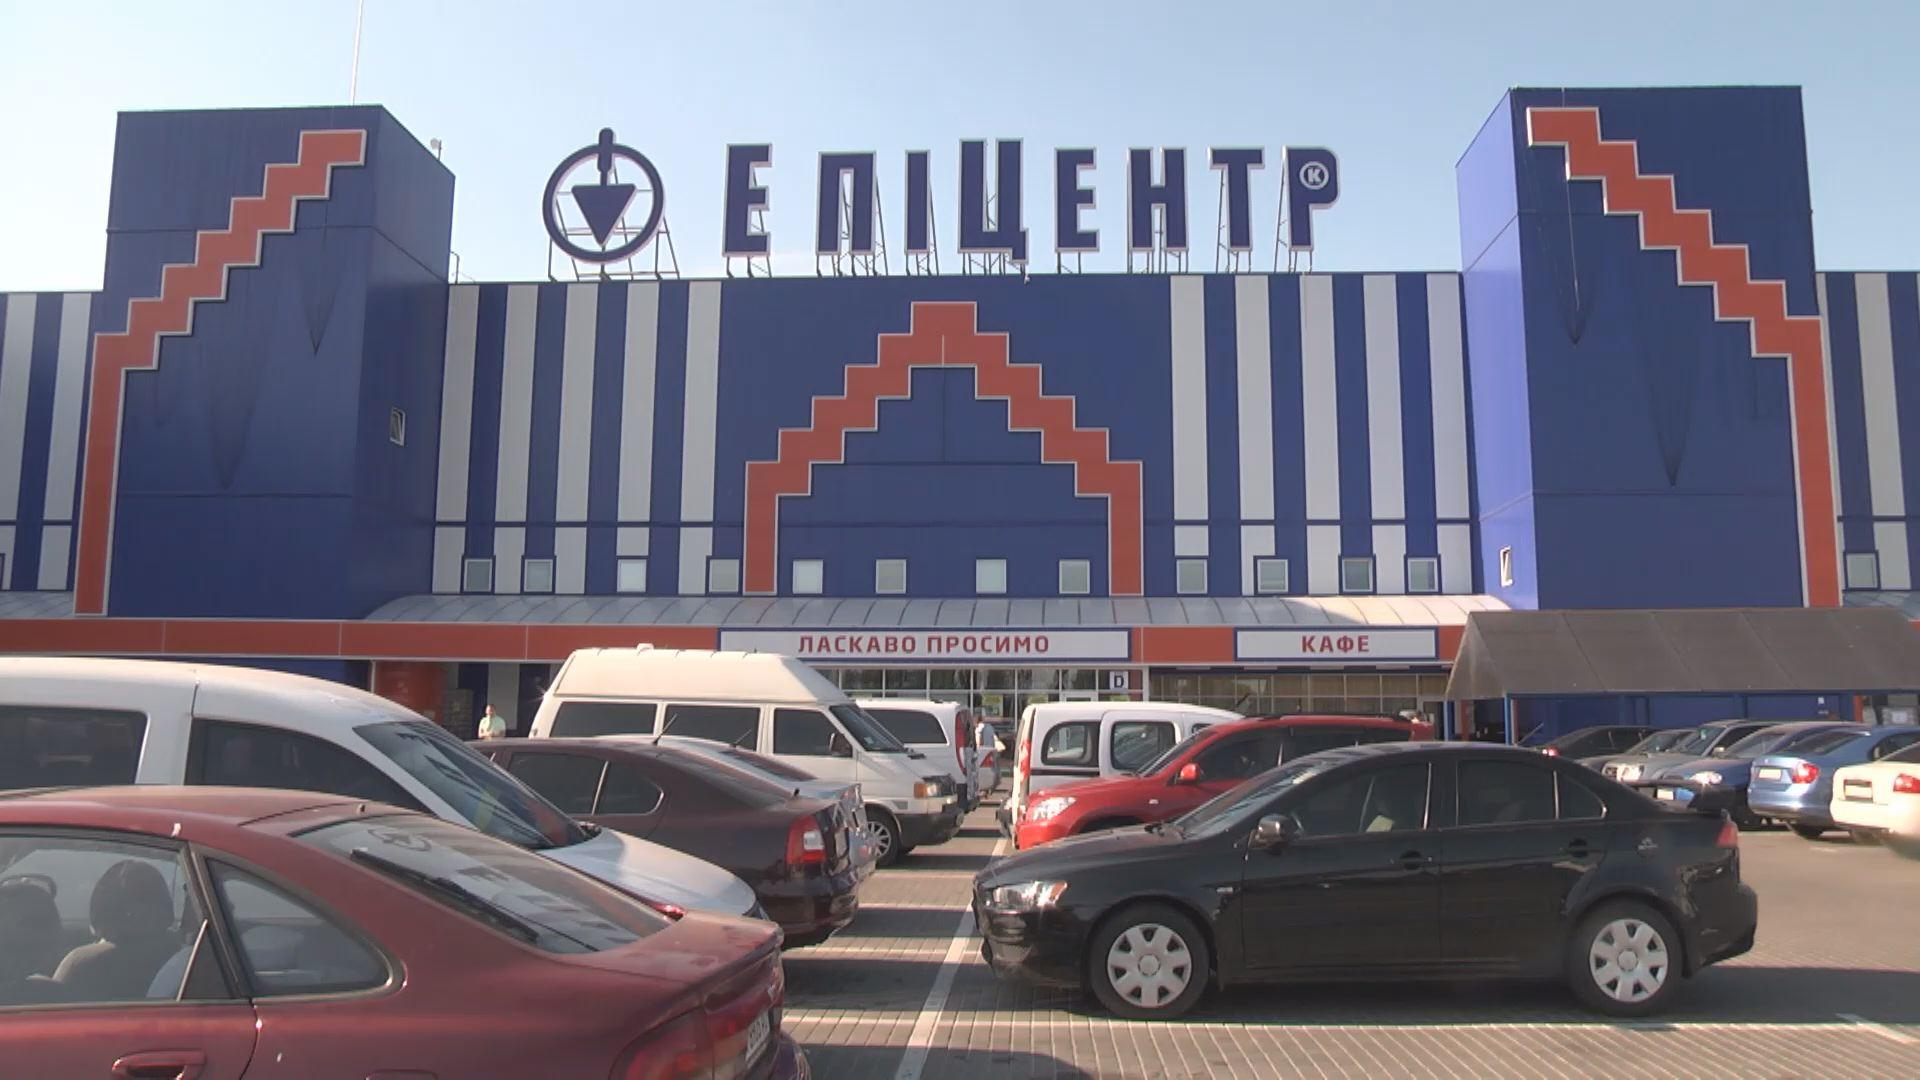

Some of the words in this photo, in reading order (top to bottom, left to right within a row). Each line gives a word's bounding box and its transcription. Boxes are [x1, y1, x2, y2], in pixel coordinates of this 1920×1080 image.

[722, 138, 1340, 265] ЕПІЦЕНТР
[799, 635, 916, 653] ЛАСКАВО
[927, 635, 1049, 653] ПРОСИМО
[1302, 635, 1369, 653] КАФЕ
